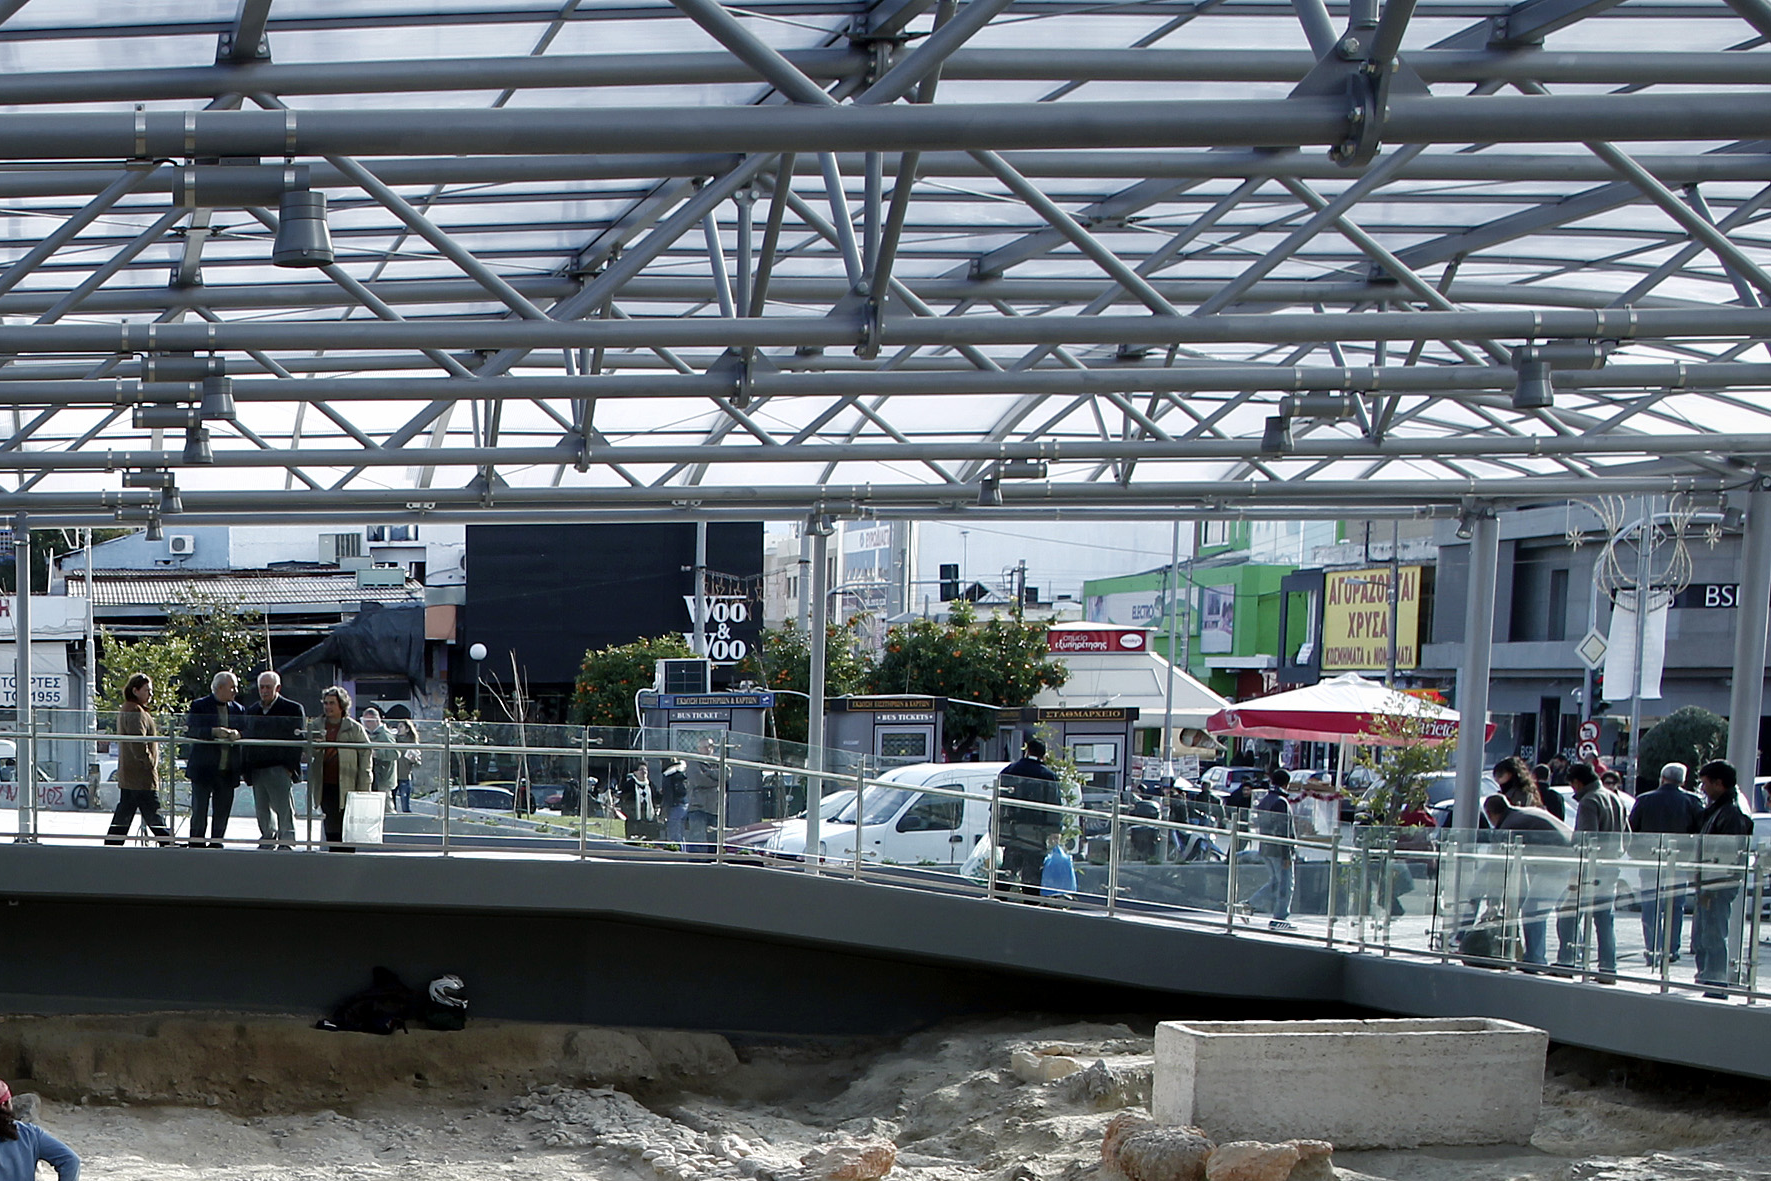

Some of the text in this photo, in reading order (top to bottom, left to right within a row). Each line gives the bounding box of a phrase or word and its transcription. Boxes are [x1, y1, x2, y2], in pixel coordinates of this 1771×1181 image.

[1328, 571, 1416, 606] ΑΓΟΡΑΖΟΤΑΙ
[1705, 585, 1740, 607] BS
[683, 595, 747, 623] Woo
[1132, 605, 1155, 620] ELECTRO
[717, 622, 731, 640] &
[1347, 610, 1389, 638] ΧΡΥΣΑ
[1055, 639, 1107, 650] εξυπηρέτησης
[1373, 646, 1413, 666] ΝΟΜΜΑΤΑ
[1, 676, 61, 689] ΤΟΡΤΕΣ
[31, 691, 61, 702] 1955
[677, 711, 722, 719] BUS TICKET
[897, 713, 929, 721] TICKETS
